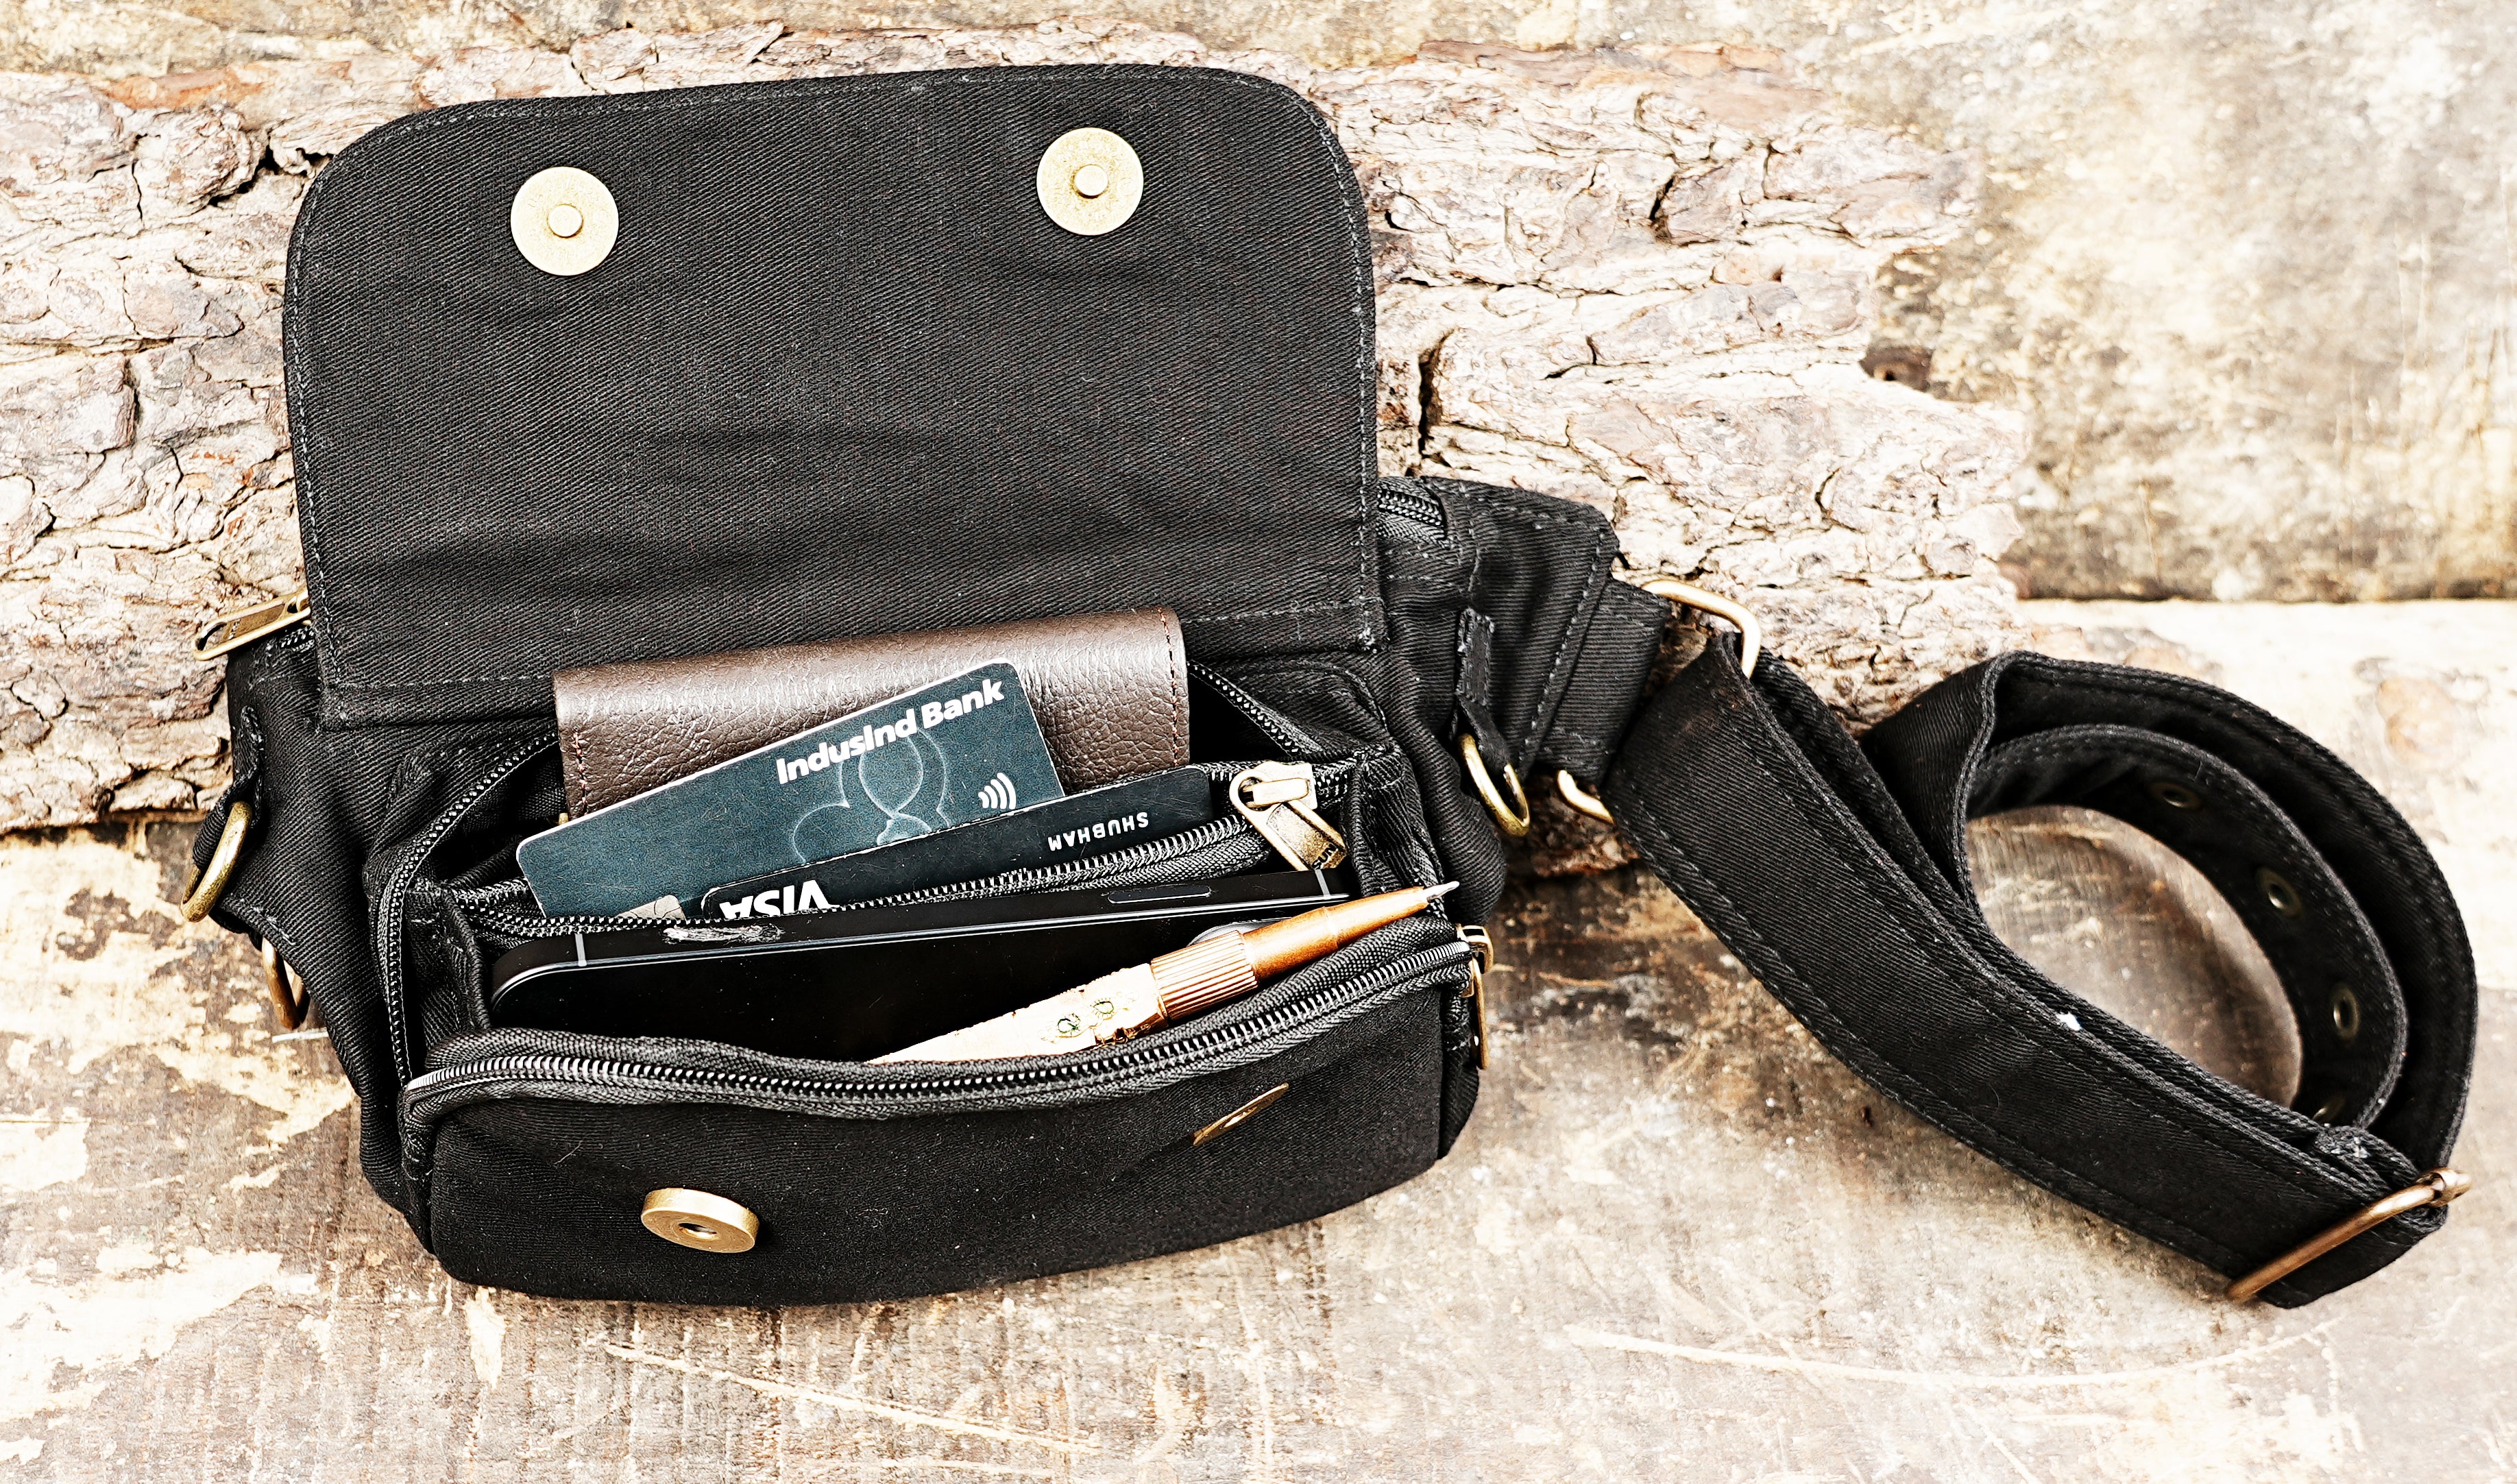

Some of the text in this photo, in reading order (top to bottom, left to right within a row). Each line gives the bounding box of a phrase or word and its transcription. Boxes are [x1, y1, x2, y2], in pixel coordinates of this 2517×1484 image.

[776, 679, 1005, 785] IndusInd Bank
[1047, 812, 1150, 851] SHUBHAM
[719, 879, 840, 919] VISA
